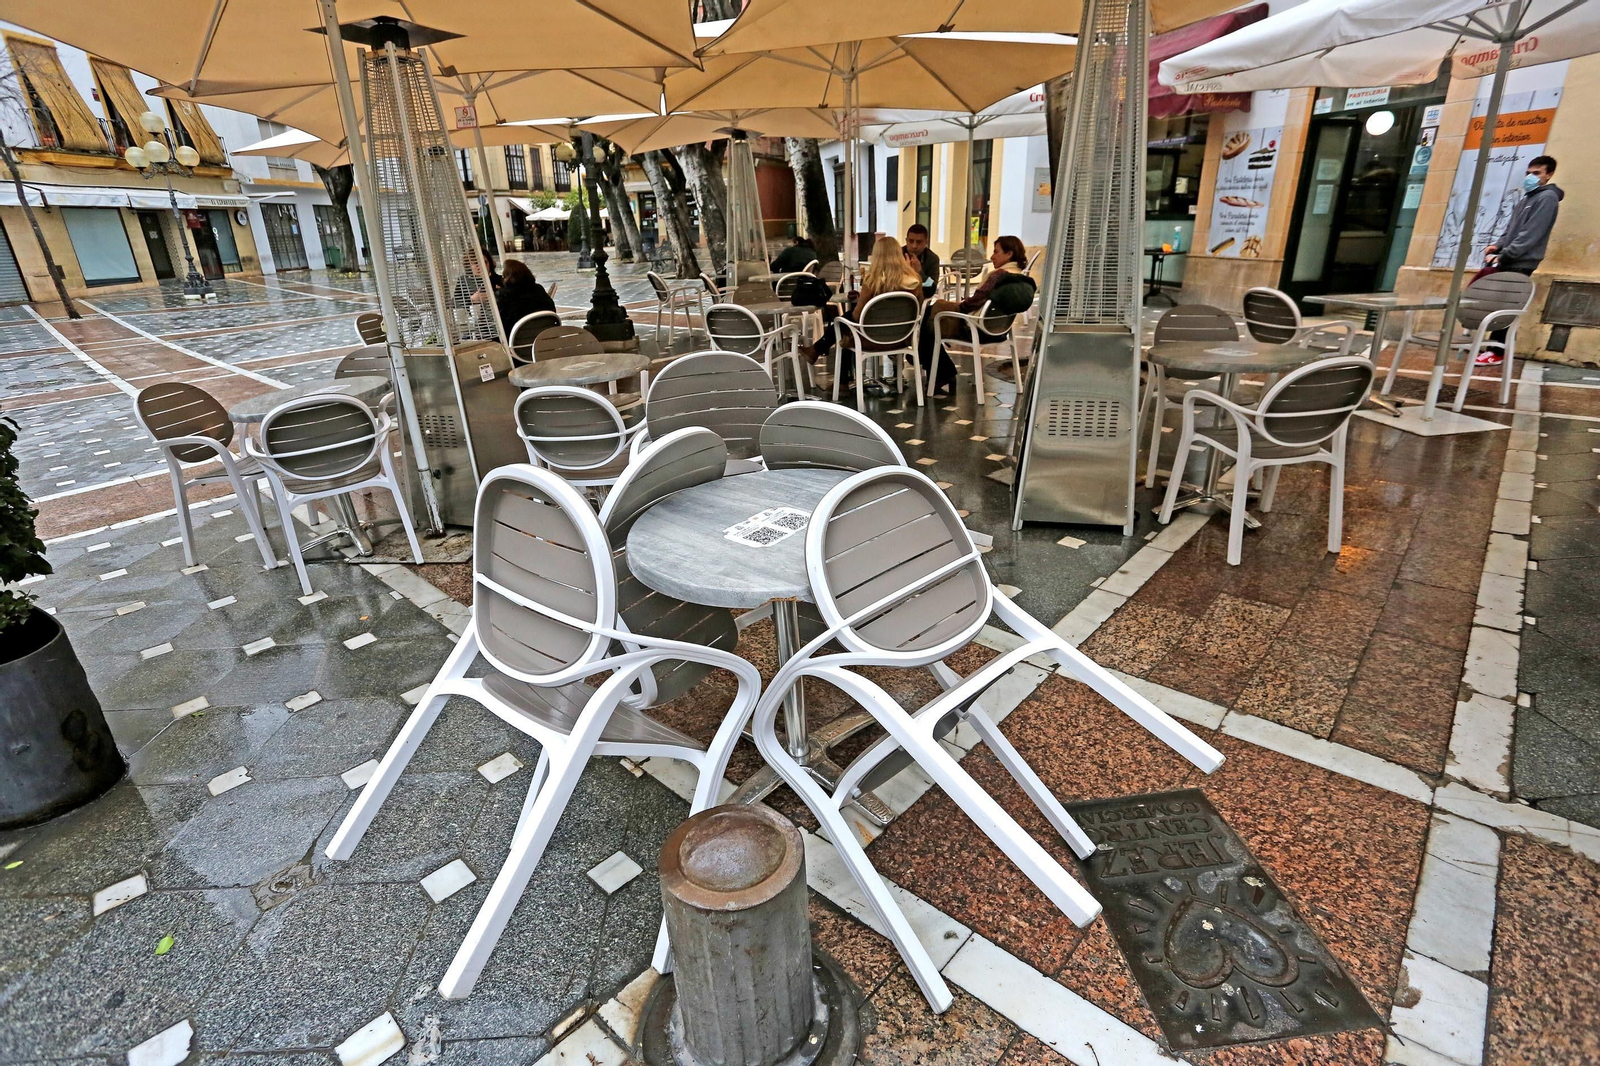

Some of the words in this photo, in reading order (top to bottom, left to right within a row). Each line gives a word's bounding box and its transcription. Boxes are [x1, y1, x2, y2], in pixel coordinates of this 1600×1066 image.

[1506, 117, 1516, 127] de
[1518, 114, 1548, 126] nuestro
[1502, 133, 1531, 143] interior
[1100, 834, 1234, 879] JEREZ
